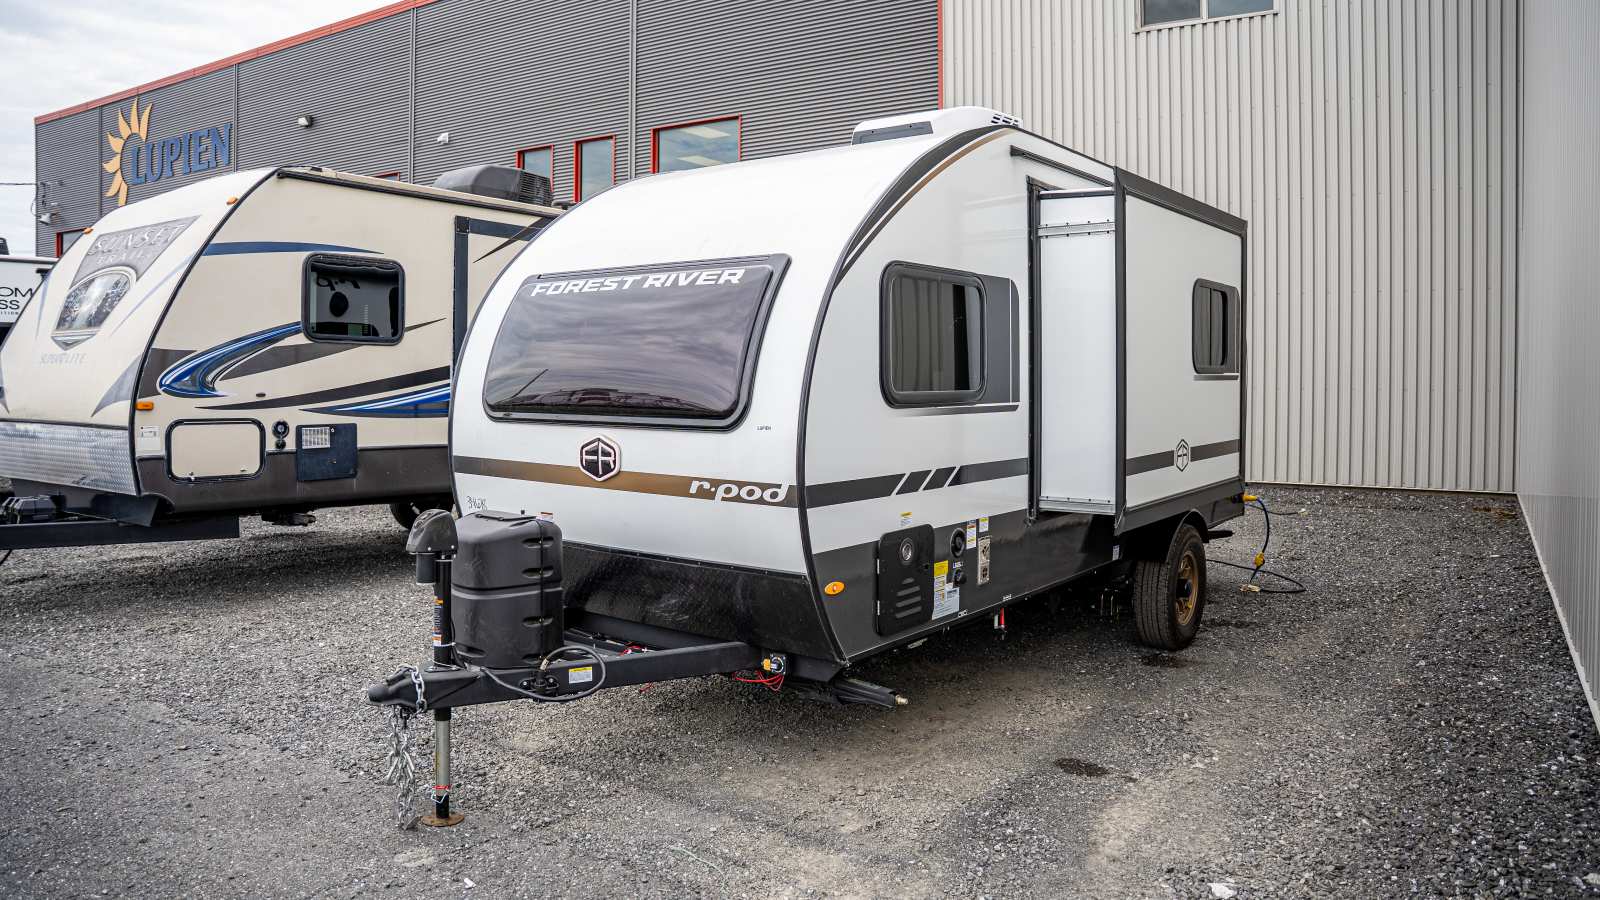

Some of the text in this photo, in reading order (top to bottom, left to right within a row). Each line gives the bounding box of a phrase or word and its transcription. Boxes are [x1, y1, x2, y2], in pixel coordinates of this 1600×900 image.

[129, 122, 232, 186] LUPIEN
[530, 268, 746, 297] FOREST RIVER
